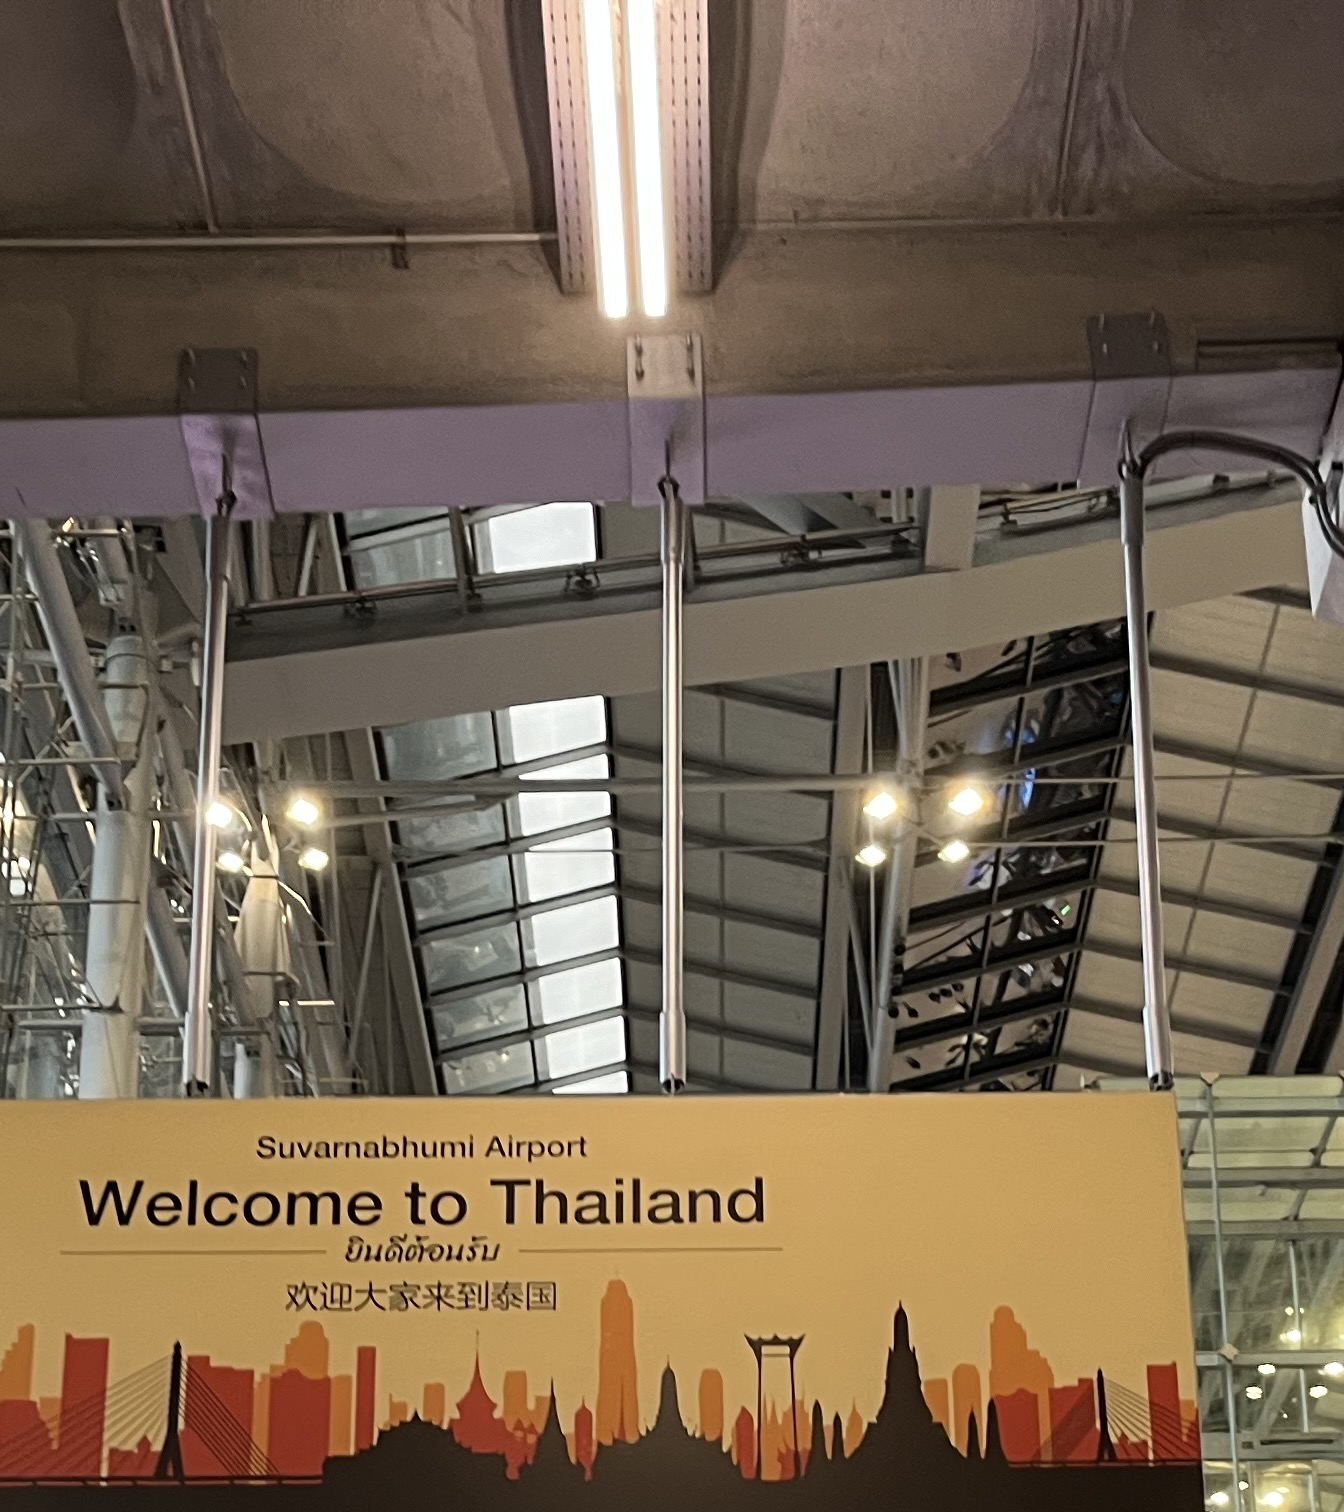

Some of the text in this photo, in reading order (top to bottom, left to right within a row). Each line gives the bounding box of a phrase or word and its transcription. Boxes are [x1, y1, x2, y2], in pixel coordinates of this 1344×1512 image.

[256, 1134, 588, 1163] Suvarnabhumi Airport
[78, 1176, 766, 1227] Welcome to Thailand
[345, 1235, 500, 1265] ยินดีต้อนรับ
[285, 1280, 557, 1313] 欢迎大家来到泰国
